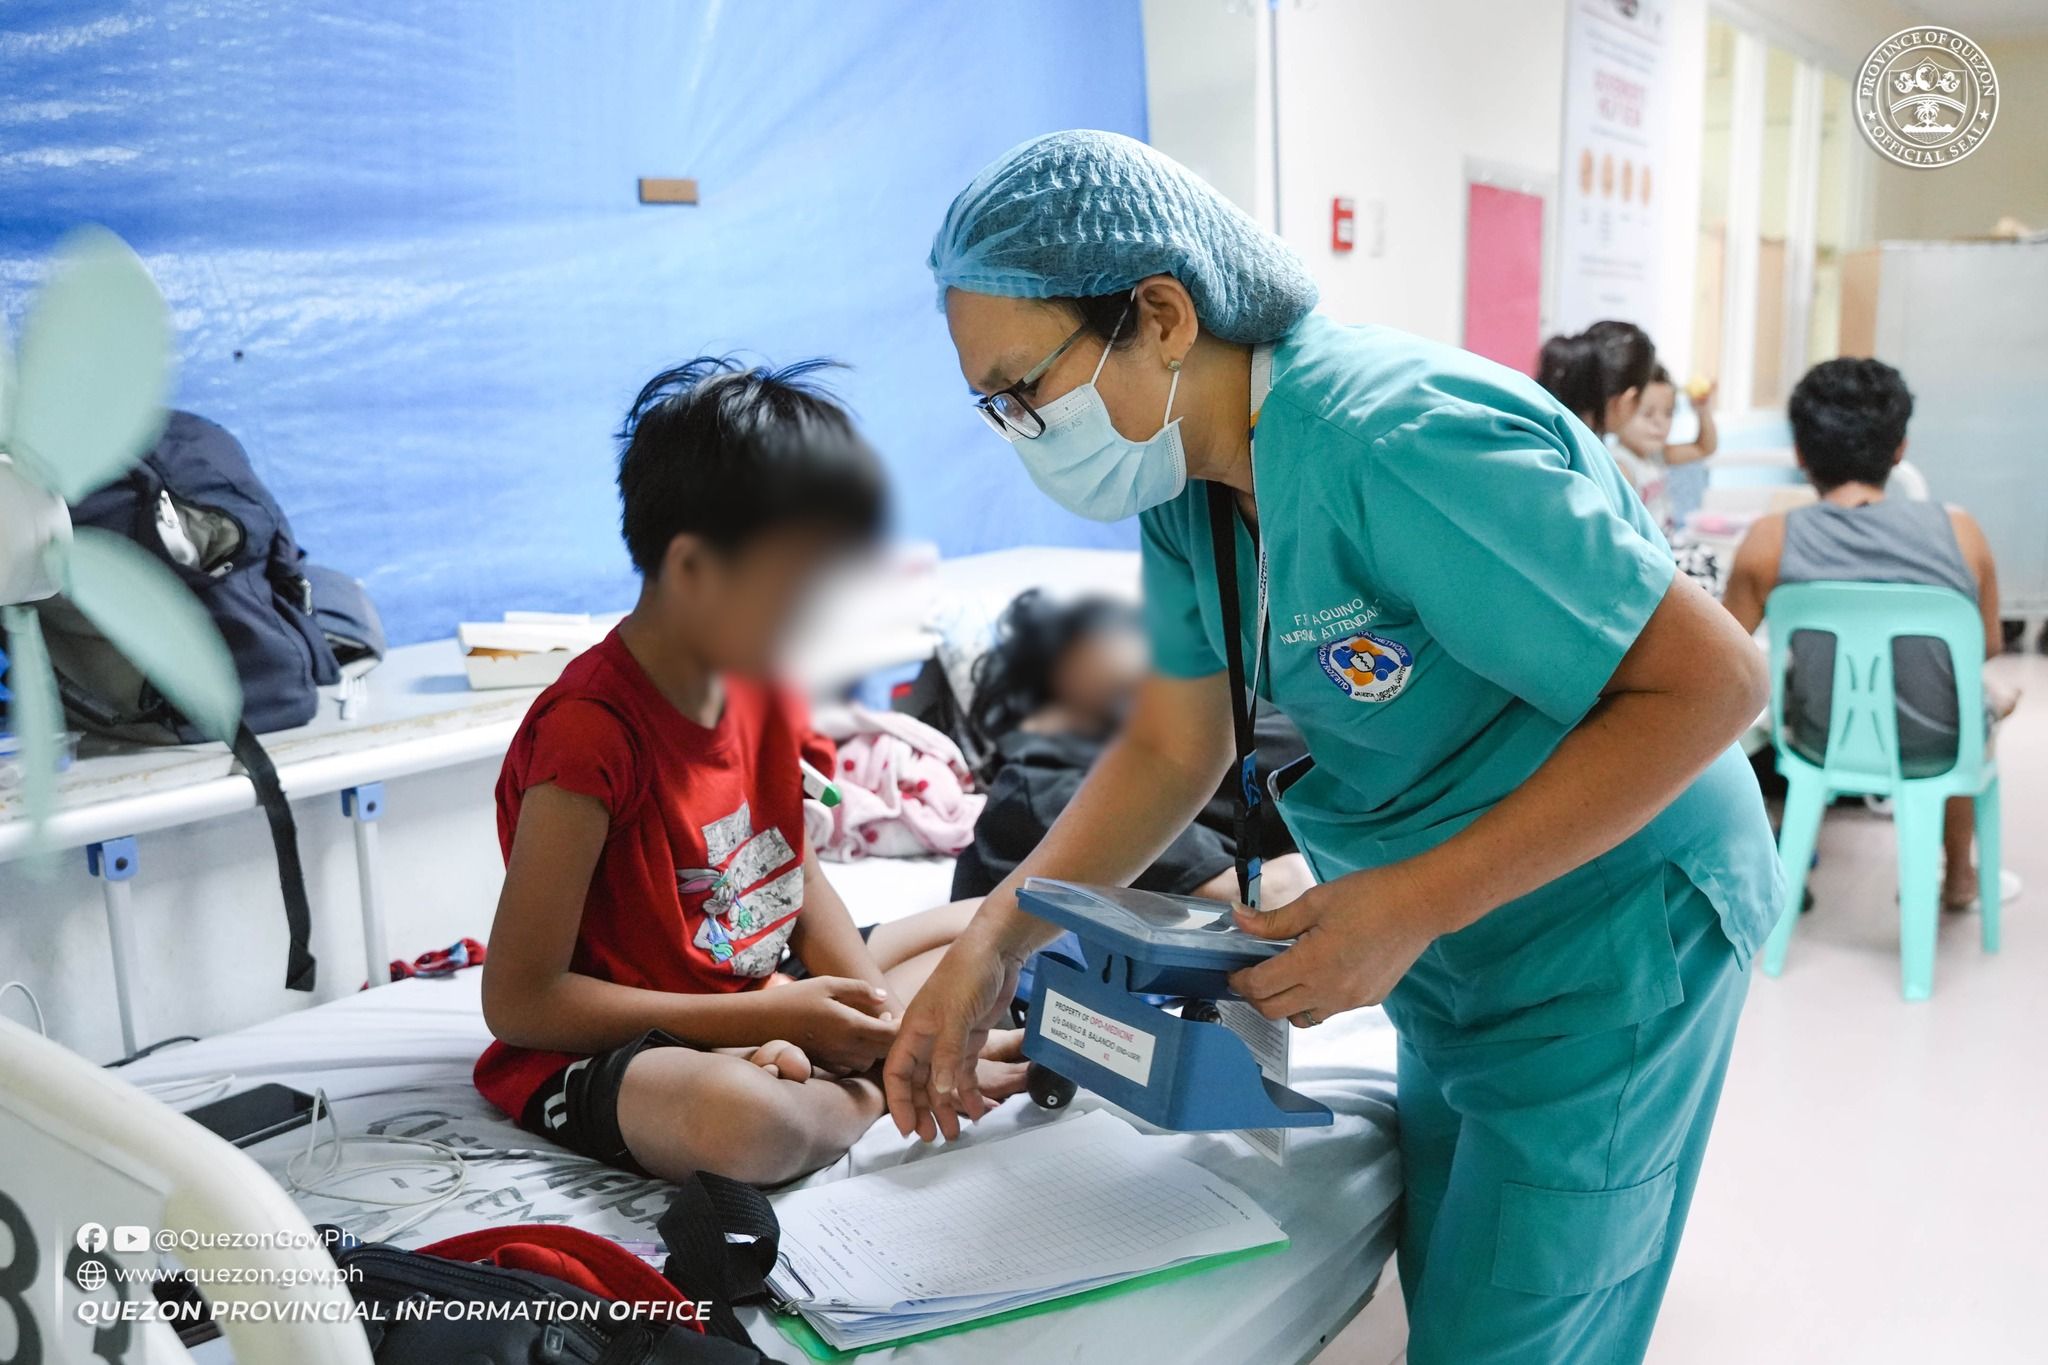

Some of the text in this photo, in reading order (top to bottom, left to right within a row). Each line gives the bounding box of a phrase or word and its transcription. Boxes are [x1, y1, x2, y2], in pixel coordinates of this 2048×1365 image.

[1312, 598, 1364, 625] AQUINO
[1055, 1001, 1081, 1018] PROPERTY
[1081, 1012, 1090, 1022] OF
